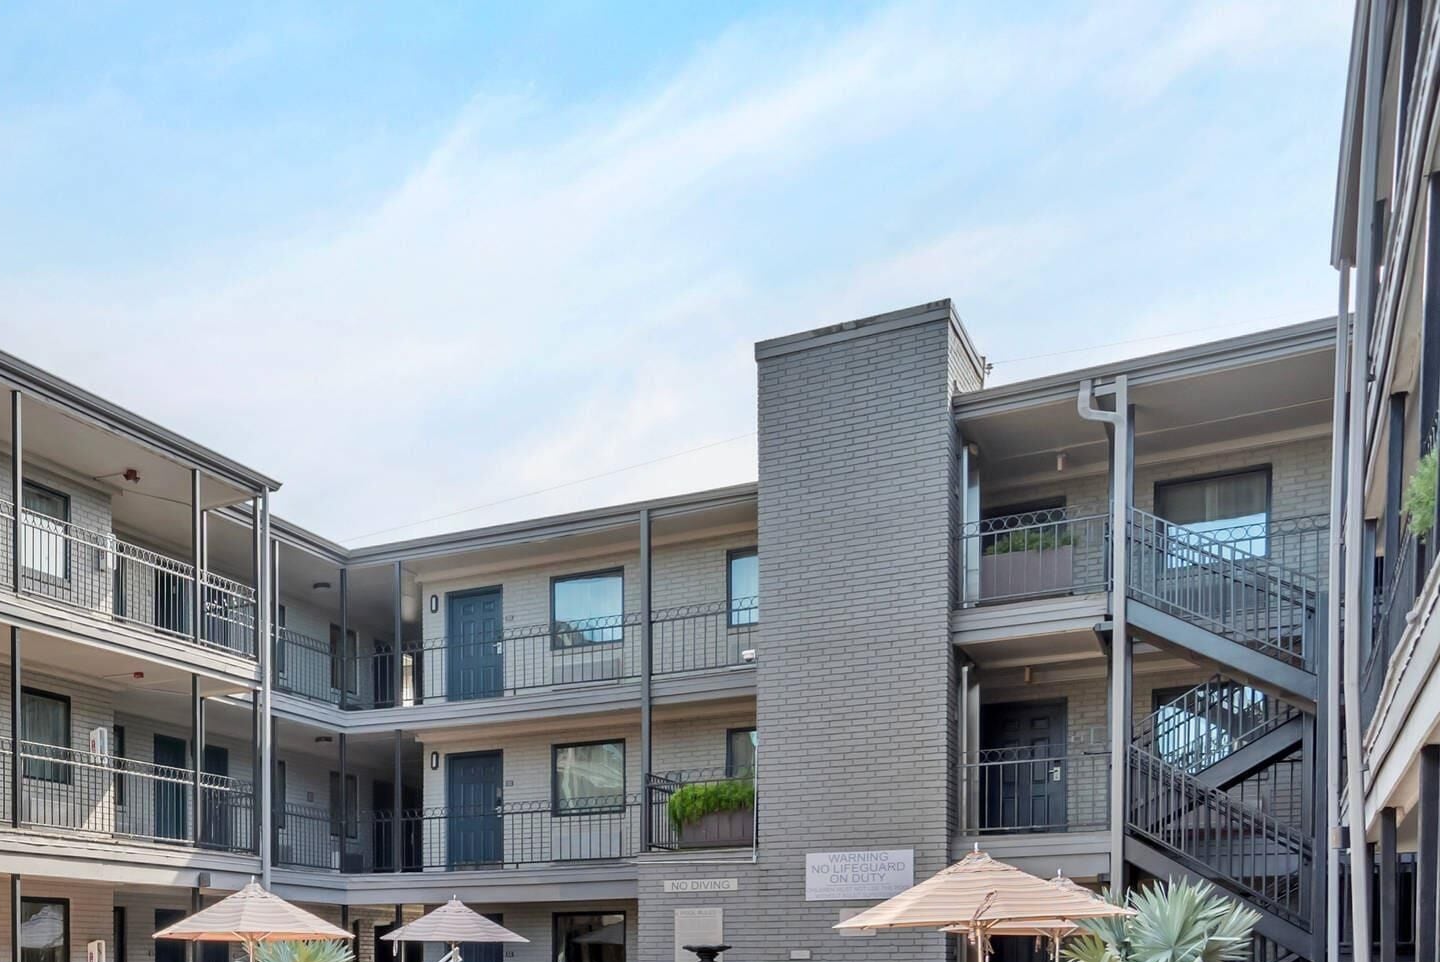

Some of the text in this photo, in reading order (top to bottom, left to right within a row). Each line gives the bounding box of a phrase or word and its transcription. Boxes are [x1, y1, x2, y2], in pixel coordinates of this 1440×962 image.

[828, 852, 888, 862] WARNING
[811, 862, 905, 874] NO LIFEGUARD
[830, 873, 885, 883] ON DUTY
[671, 880, 729, 891] NO DIVING
